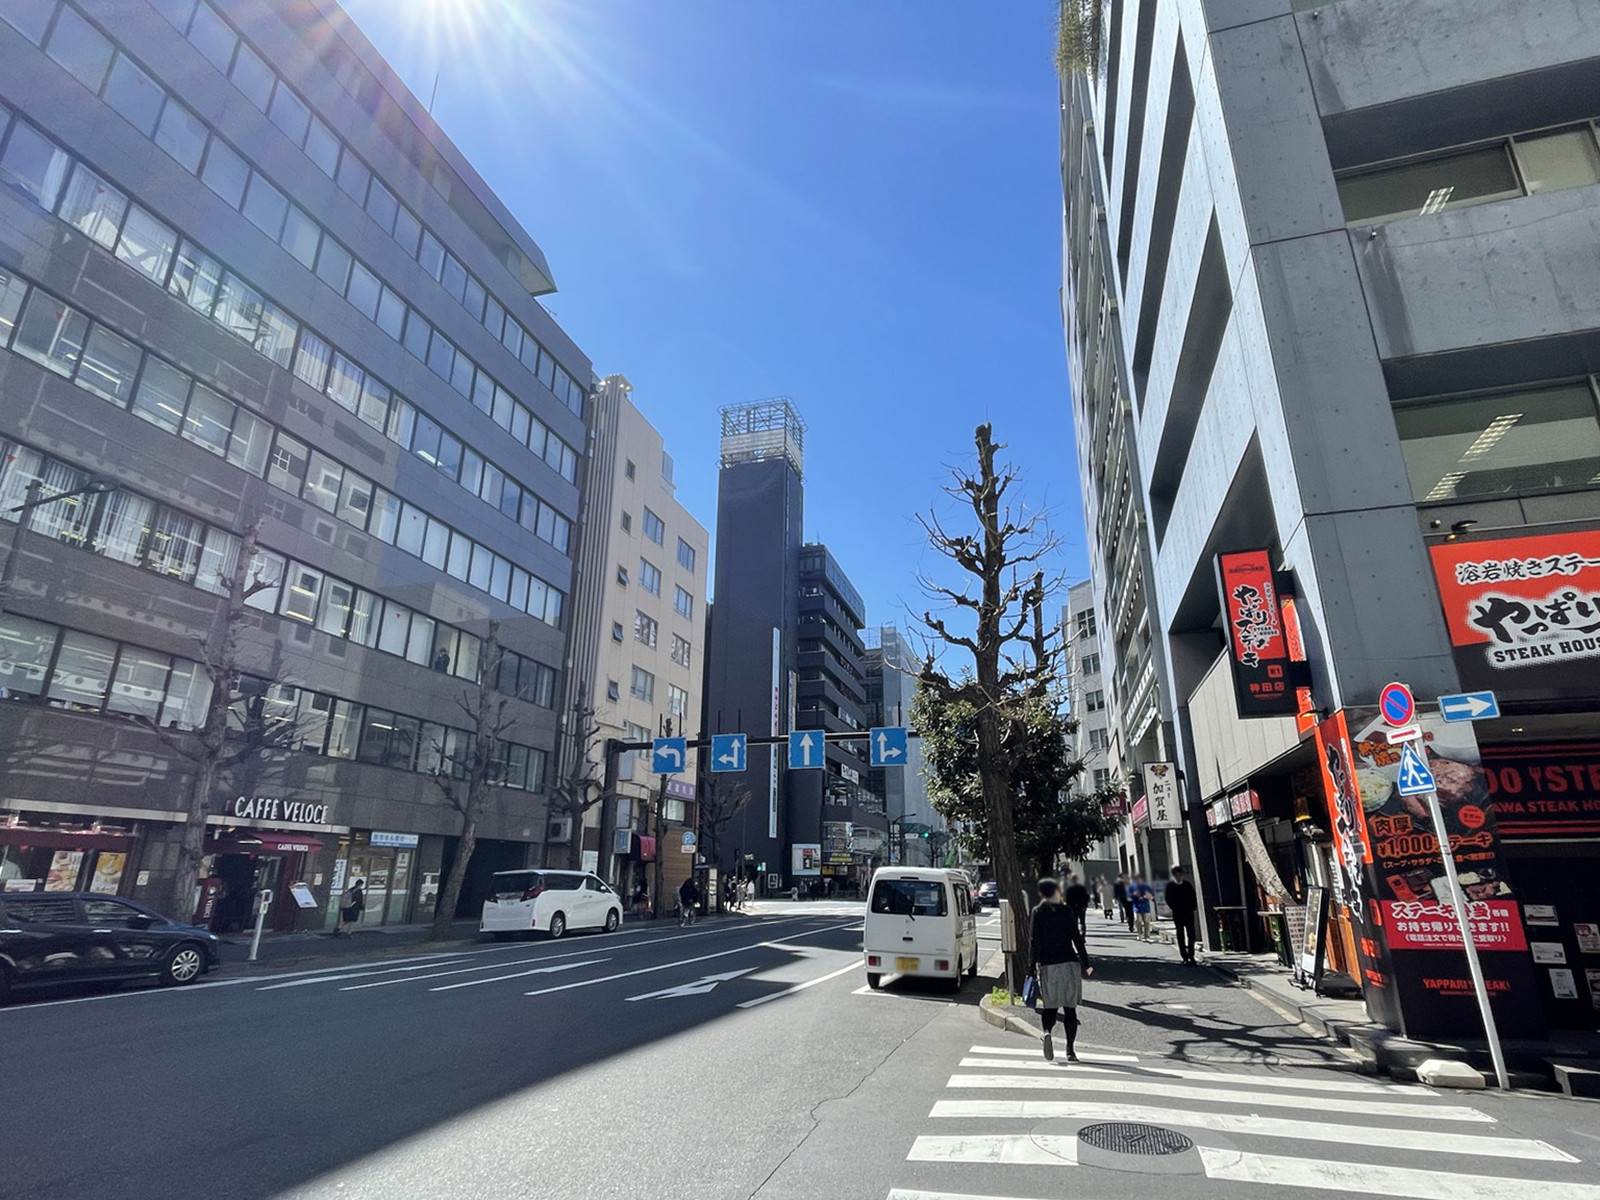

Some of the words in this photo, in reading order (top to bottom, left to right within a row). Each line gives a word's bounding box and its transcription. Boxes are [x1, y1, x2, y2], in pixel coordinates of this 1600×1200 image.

[1494, 644, 1555, 663] STEAK
[1250, 682, 1285, 693] 神田店
[1164, 780, 1172, 799] ニュー
[1152, 782, 1169, 822] 加賀屋
[1527, 800, 1579, 813] STEAK
[283, 800, 329, 824] VELOCE
[1375, 815, 1411, 836] 肉厚
[1378, 832, 1493, 856] ¥1,000テーキ
[1391, 901, 1490, 920] ステーキ当
